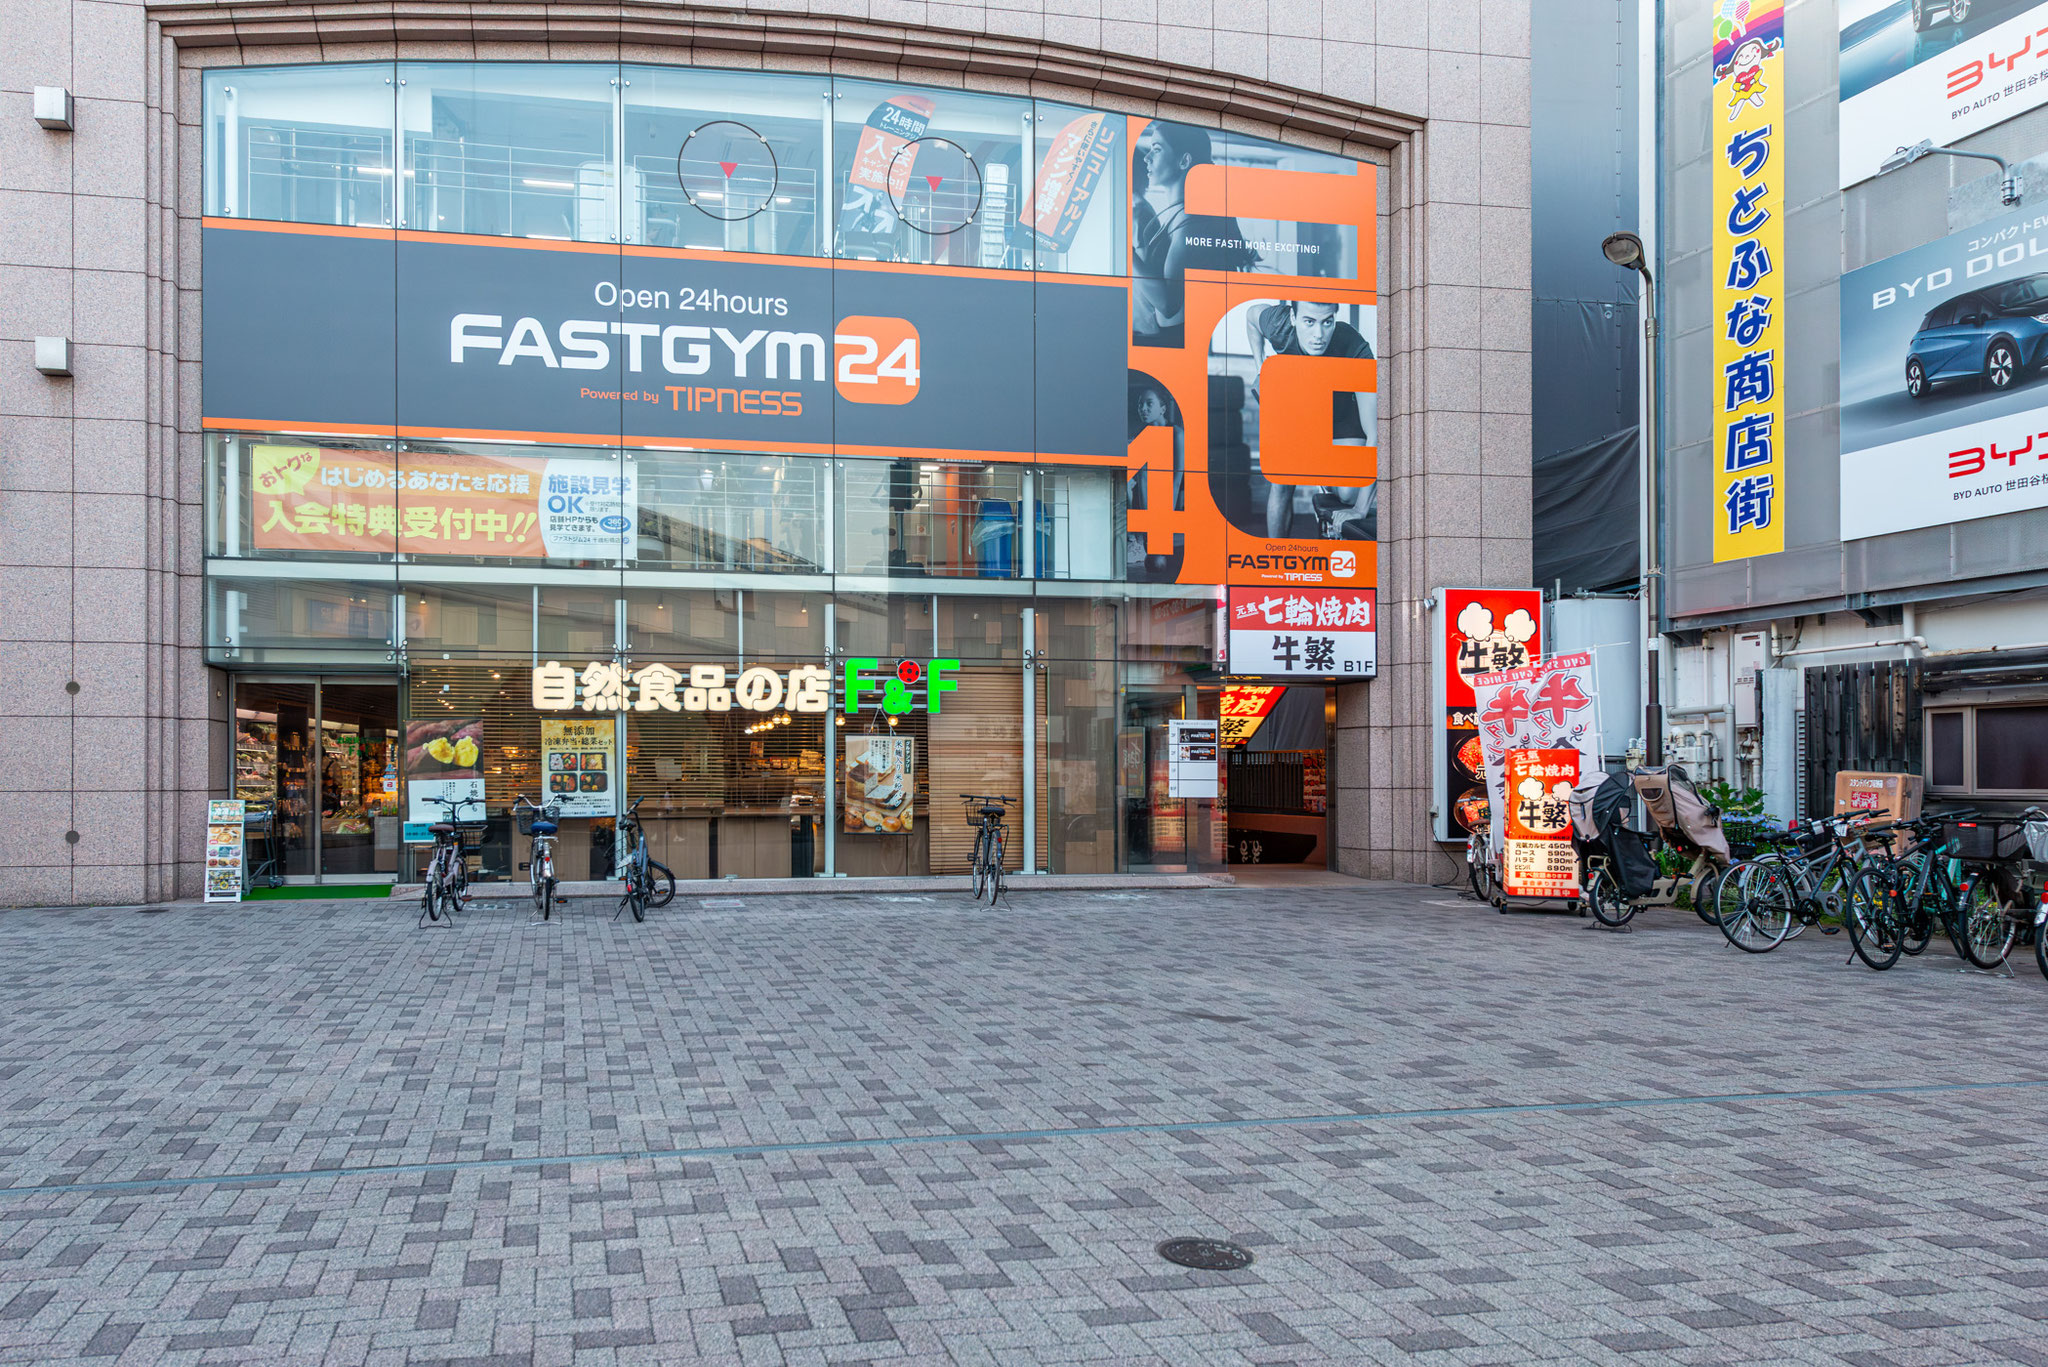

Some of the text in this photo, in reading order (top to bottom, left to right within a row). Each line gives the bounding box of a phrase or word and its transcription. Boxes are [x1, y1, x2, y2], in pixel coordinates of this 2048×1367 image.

[1951, 105, 1970, 120] BYD
[1972, 92, 2000, 111] AUTO
[882, 107, 926, 136] 24時間
[864, 135, 913, 168] 入会
[1060, 126, 1116, 236] リニューアル!
[1185, 236, 1320, 254] MORE FAST! MORE EXCITING!
[594, 281, 788, 316] Open 24hours
[1873, 267, 1953, 310] BYD
[1725, 123, 1774, 534] ちとふな商店街
[451, 313, 921, 386] FASTGYM 24
[580, 385, 803, 416] Powered by TIPNESS
[259, 452, 313, 489] おトクな
[321, 467, 530, 494] はじめるあなたを応援
[548, 474, 632, 496] 施設見学
[1953, 489, 1972, 501] BYD
[1974, 484, 2003, 497] AUTO
[547, 495, 585, 514] OK
[262, 500, 537, 543] 入会特典受付中!!
[549, 524, 596, 532] 見学できます。
[1265, 543, 1319, 552] Open 24hours
[1228, 554, 1356, 572] FASTGYM 24
[1284, 573, 1323, 582] TIPNESS
[1258, 594, 1371, 627] 七輪焼肉
[1272, 635, 1336, 671] 牛繁
[1344, 660, 1374, 672] B1F
[532, 660, 832, 712] 自然食品の店
[844, 658, 961, 714] F&F
[563, 725, 595, 736] 無添加
[1514, 763, 1575, 777] 七輪焼肉
[1519, 801, 1567, 829] 牛繁
